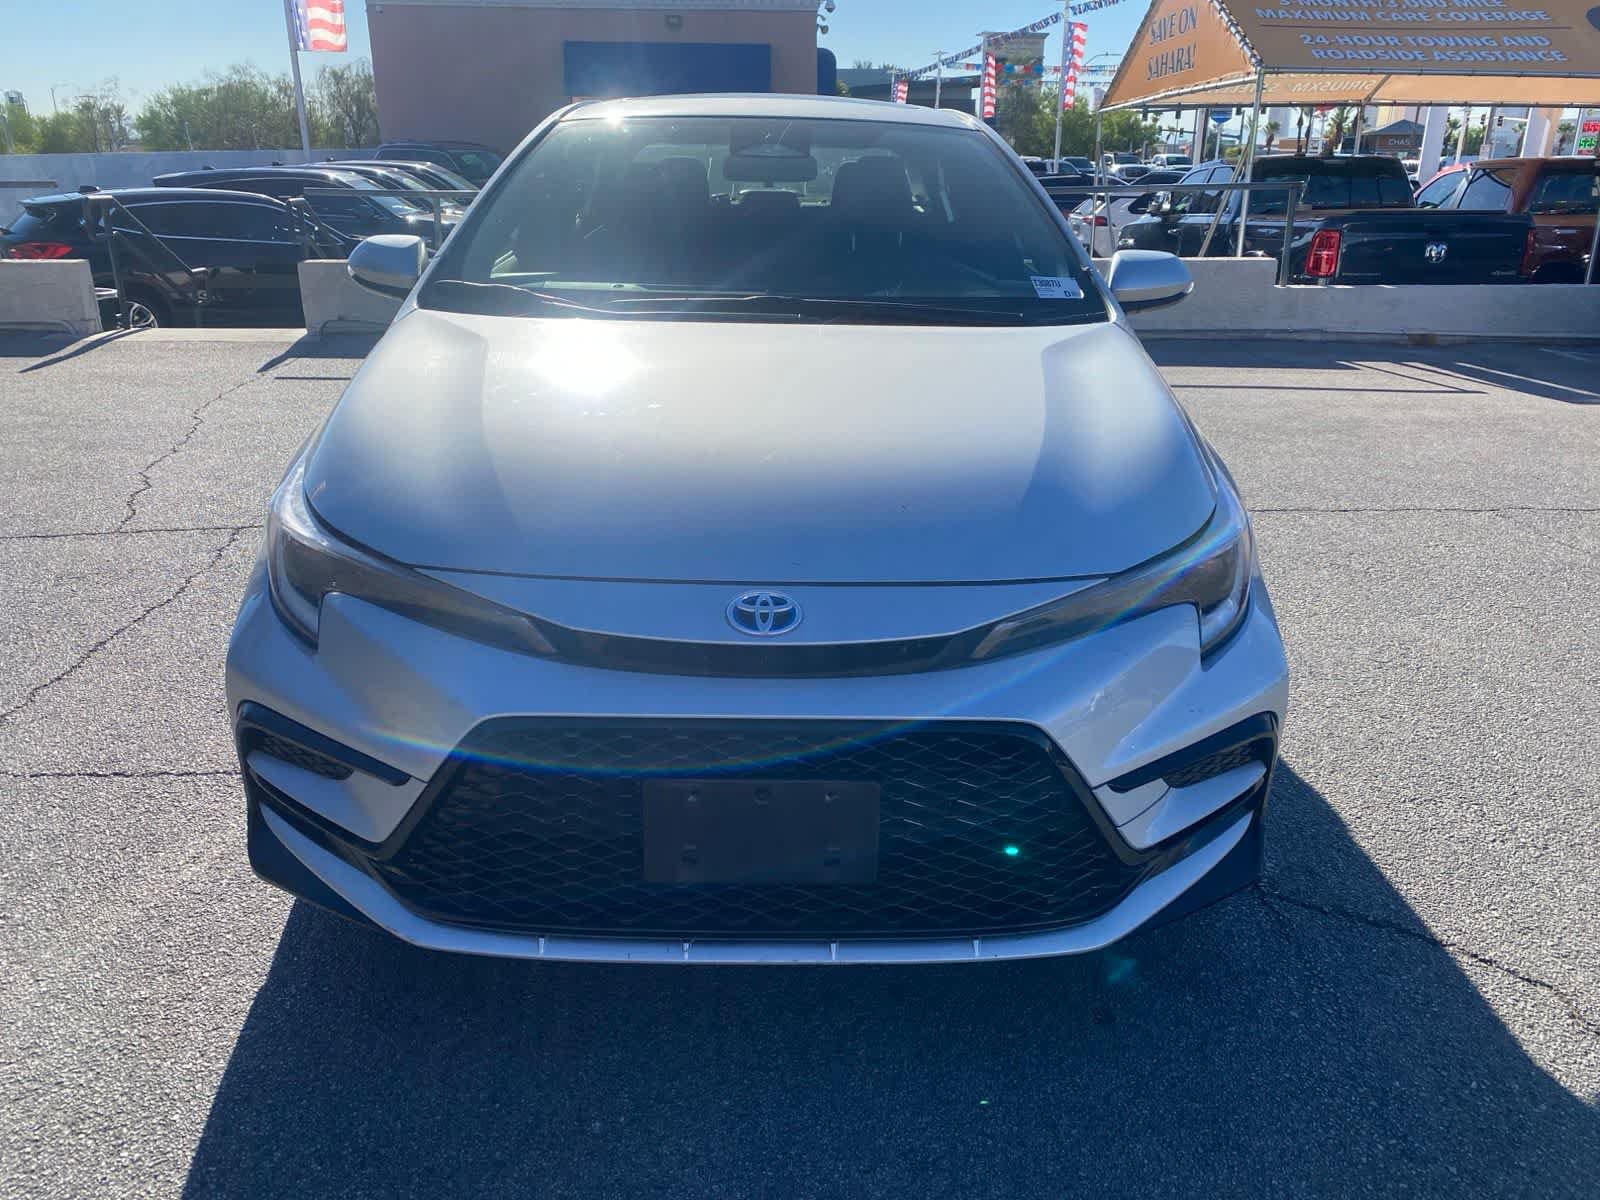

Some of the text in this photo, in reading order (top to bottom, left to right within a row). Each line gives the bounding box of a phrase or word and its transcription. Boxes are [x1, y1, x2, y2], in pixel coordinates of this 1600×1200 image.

[1256, 8, 1551, 22] MAXIMUM CARE COVERAGE
[1150, 6, 1199, 46] SAVE ON
[1300, 34, 1551, 47] 24-HOUR TOWING AND
[1147, 41, 1197, 80] SAHARA!
[1311, 48, 1568, 62] ROADSIDE ASSISTANCE
